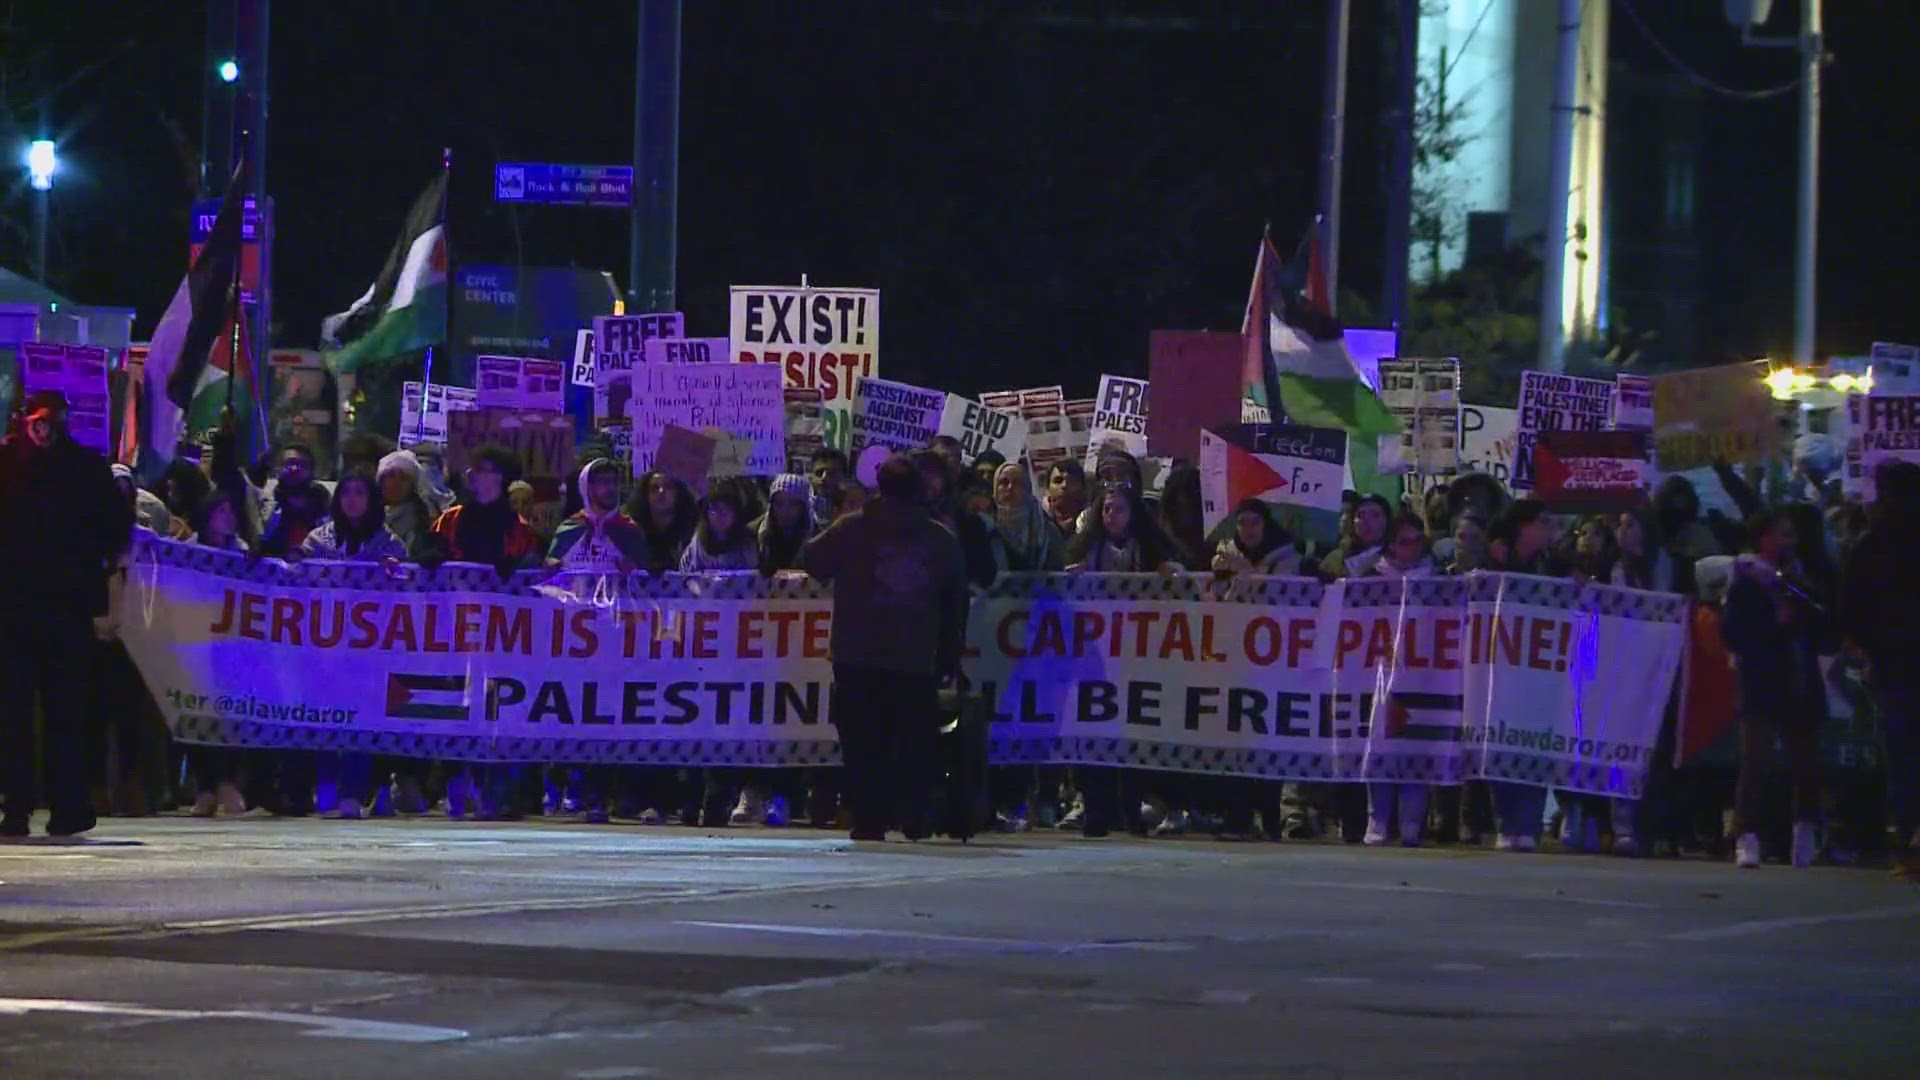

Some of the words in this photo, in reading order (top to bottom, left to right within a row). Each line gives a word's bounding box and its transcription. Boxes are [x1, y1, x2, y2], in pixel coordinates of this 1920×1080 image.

[464, 289, 516, 304] CENTER
[603, 316, 676, 353] FREE
[745, 295, 866, 345] EXIST!
[740, 351, 871, 401] SIST!
[1525, 373, 1571, 392] STAND
[1575, 379, 1611, 397] WITH
[858, 380, 941, 411] RESISTANCE
[868, 401, 925, 425] AGAINST
[962, 403, 1009, 439] END
[1521, 407, 1563, 430] END
[1571, 413, 1609, 431] THE
[1254, 427, 1336, 459] Freedom
[210, 589, 532, 656] JERUSALEM
[551, 608, 598, 658] IS
[620, 610, 719, 659] THE
[997, 612, 1228, 663] CAPITAL
[1243, 616, 1316, 668] OF
[486, 676, 835, 725] PALESTIN
[1075, 679, 1163, 726] BE
[1184, 686, 1376, 739] FREE!
